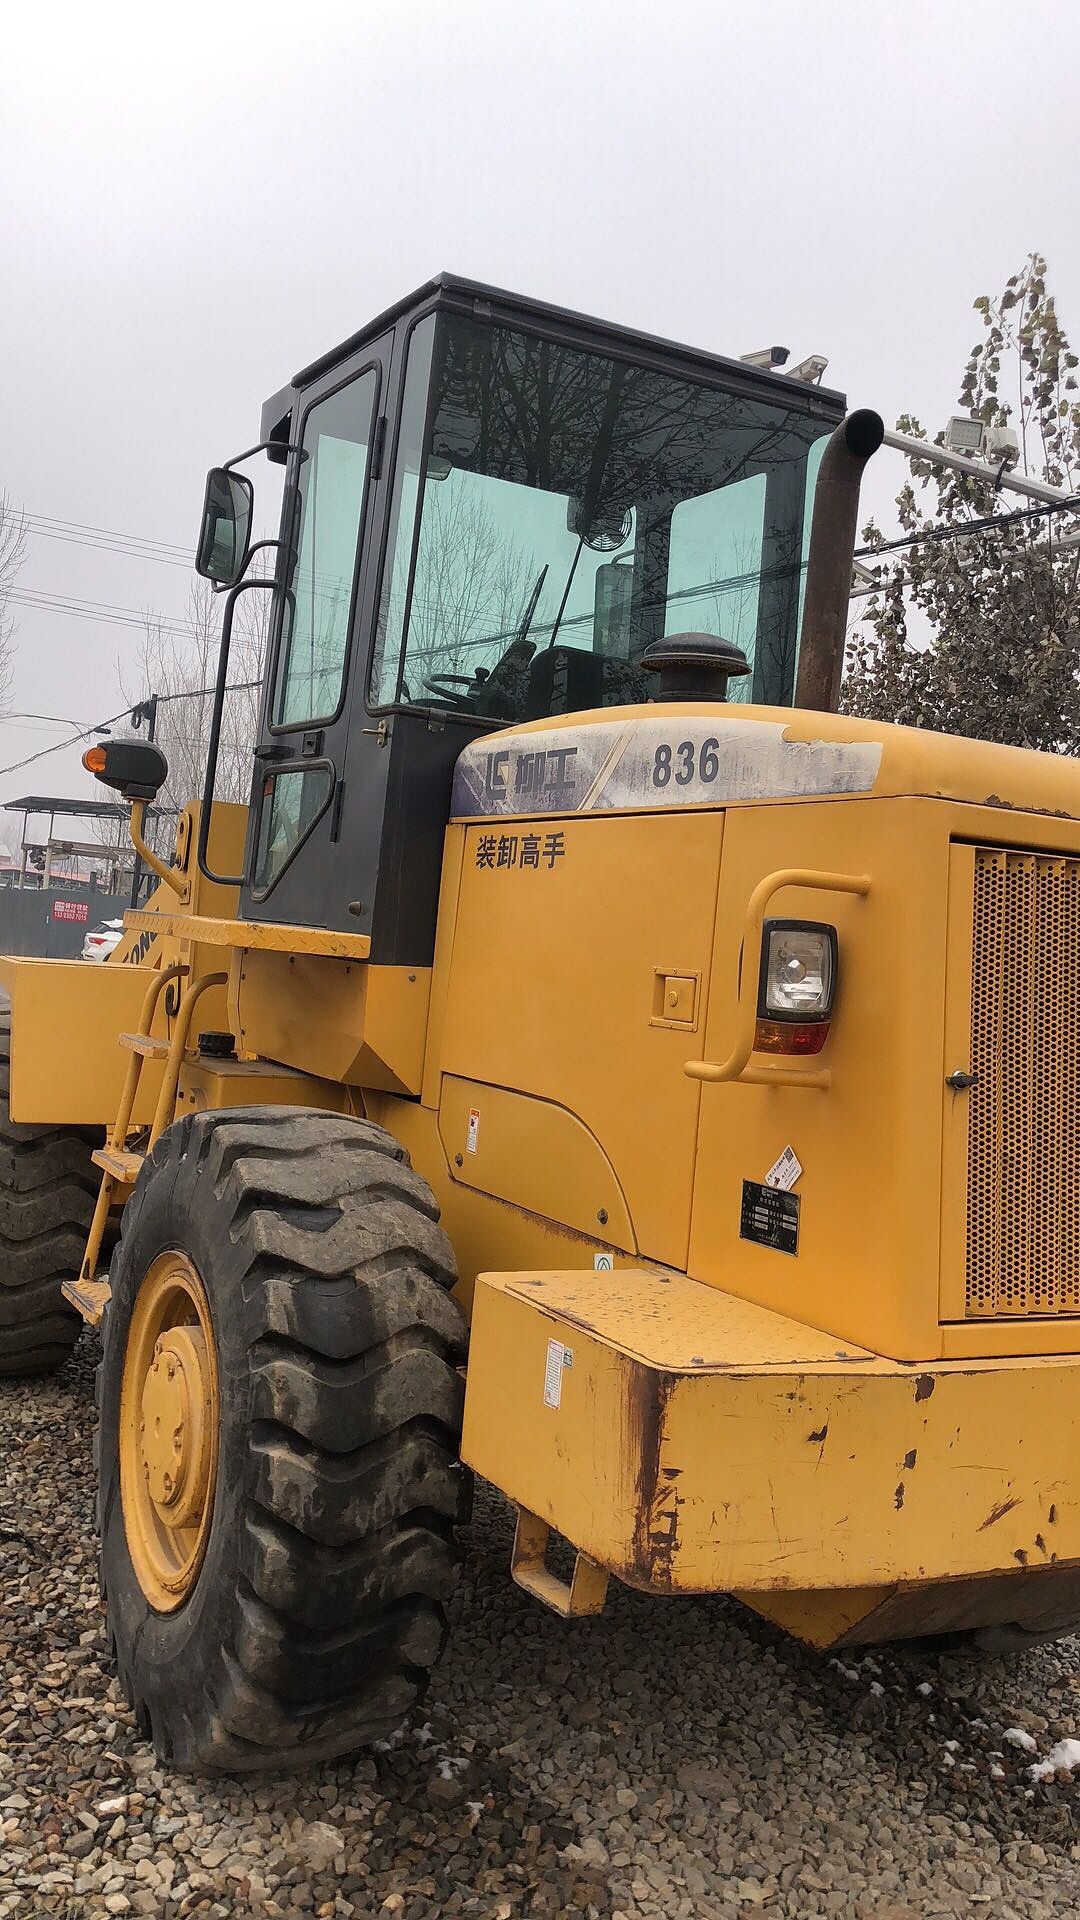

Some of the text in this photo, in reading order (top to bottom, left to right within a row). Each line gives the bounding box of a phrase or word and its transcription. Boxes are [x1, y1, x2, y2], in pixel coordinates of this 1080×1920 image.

[652, 737, 720, 788] 836
[475, 831, 566, 869] 装卸高手
